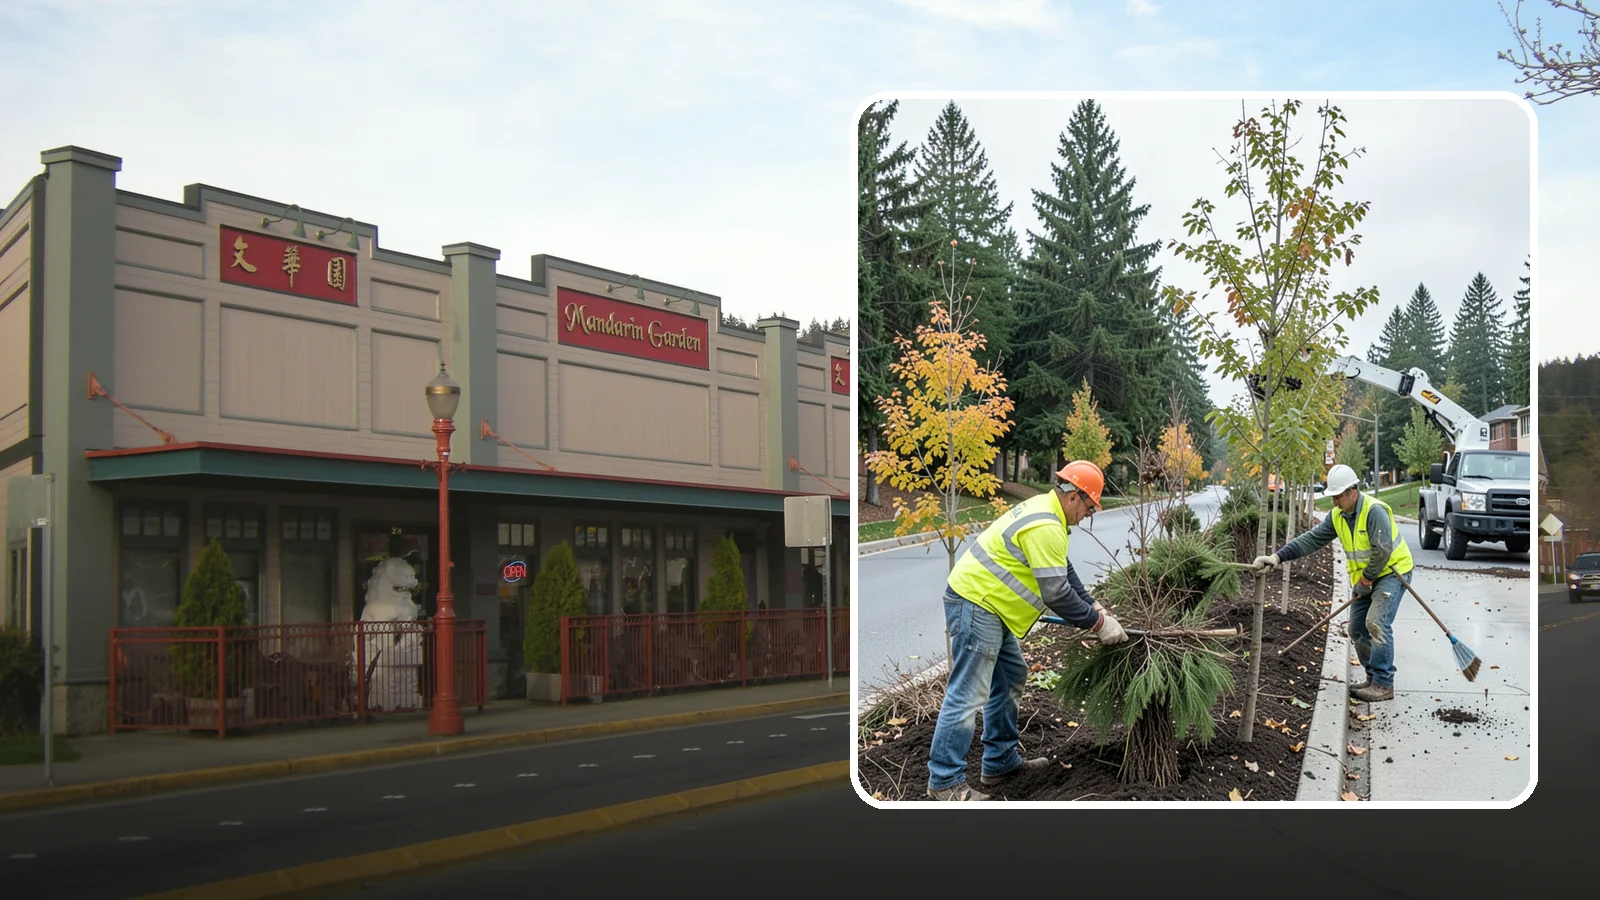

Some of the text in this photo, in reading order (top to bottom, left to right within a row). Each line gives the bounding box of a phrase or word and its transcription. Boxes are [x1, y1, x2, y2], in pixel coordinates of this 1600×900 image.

[231, 236, 346, 291] 文華園
[564, 302, 701, 352] Mandarin Garden
[503, 565, 527, 578] OPEN
